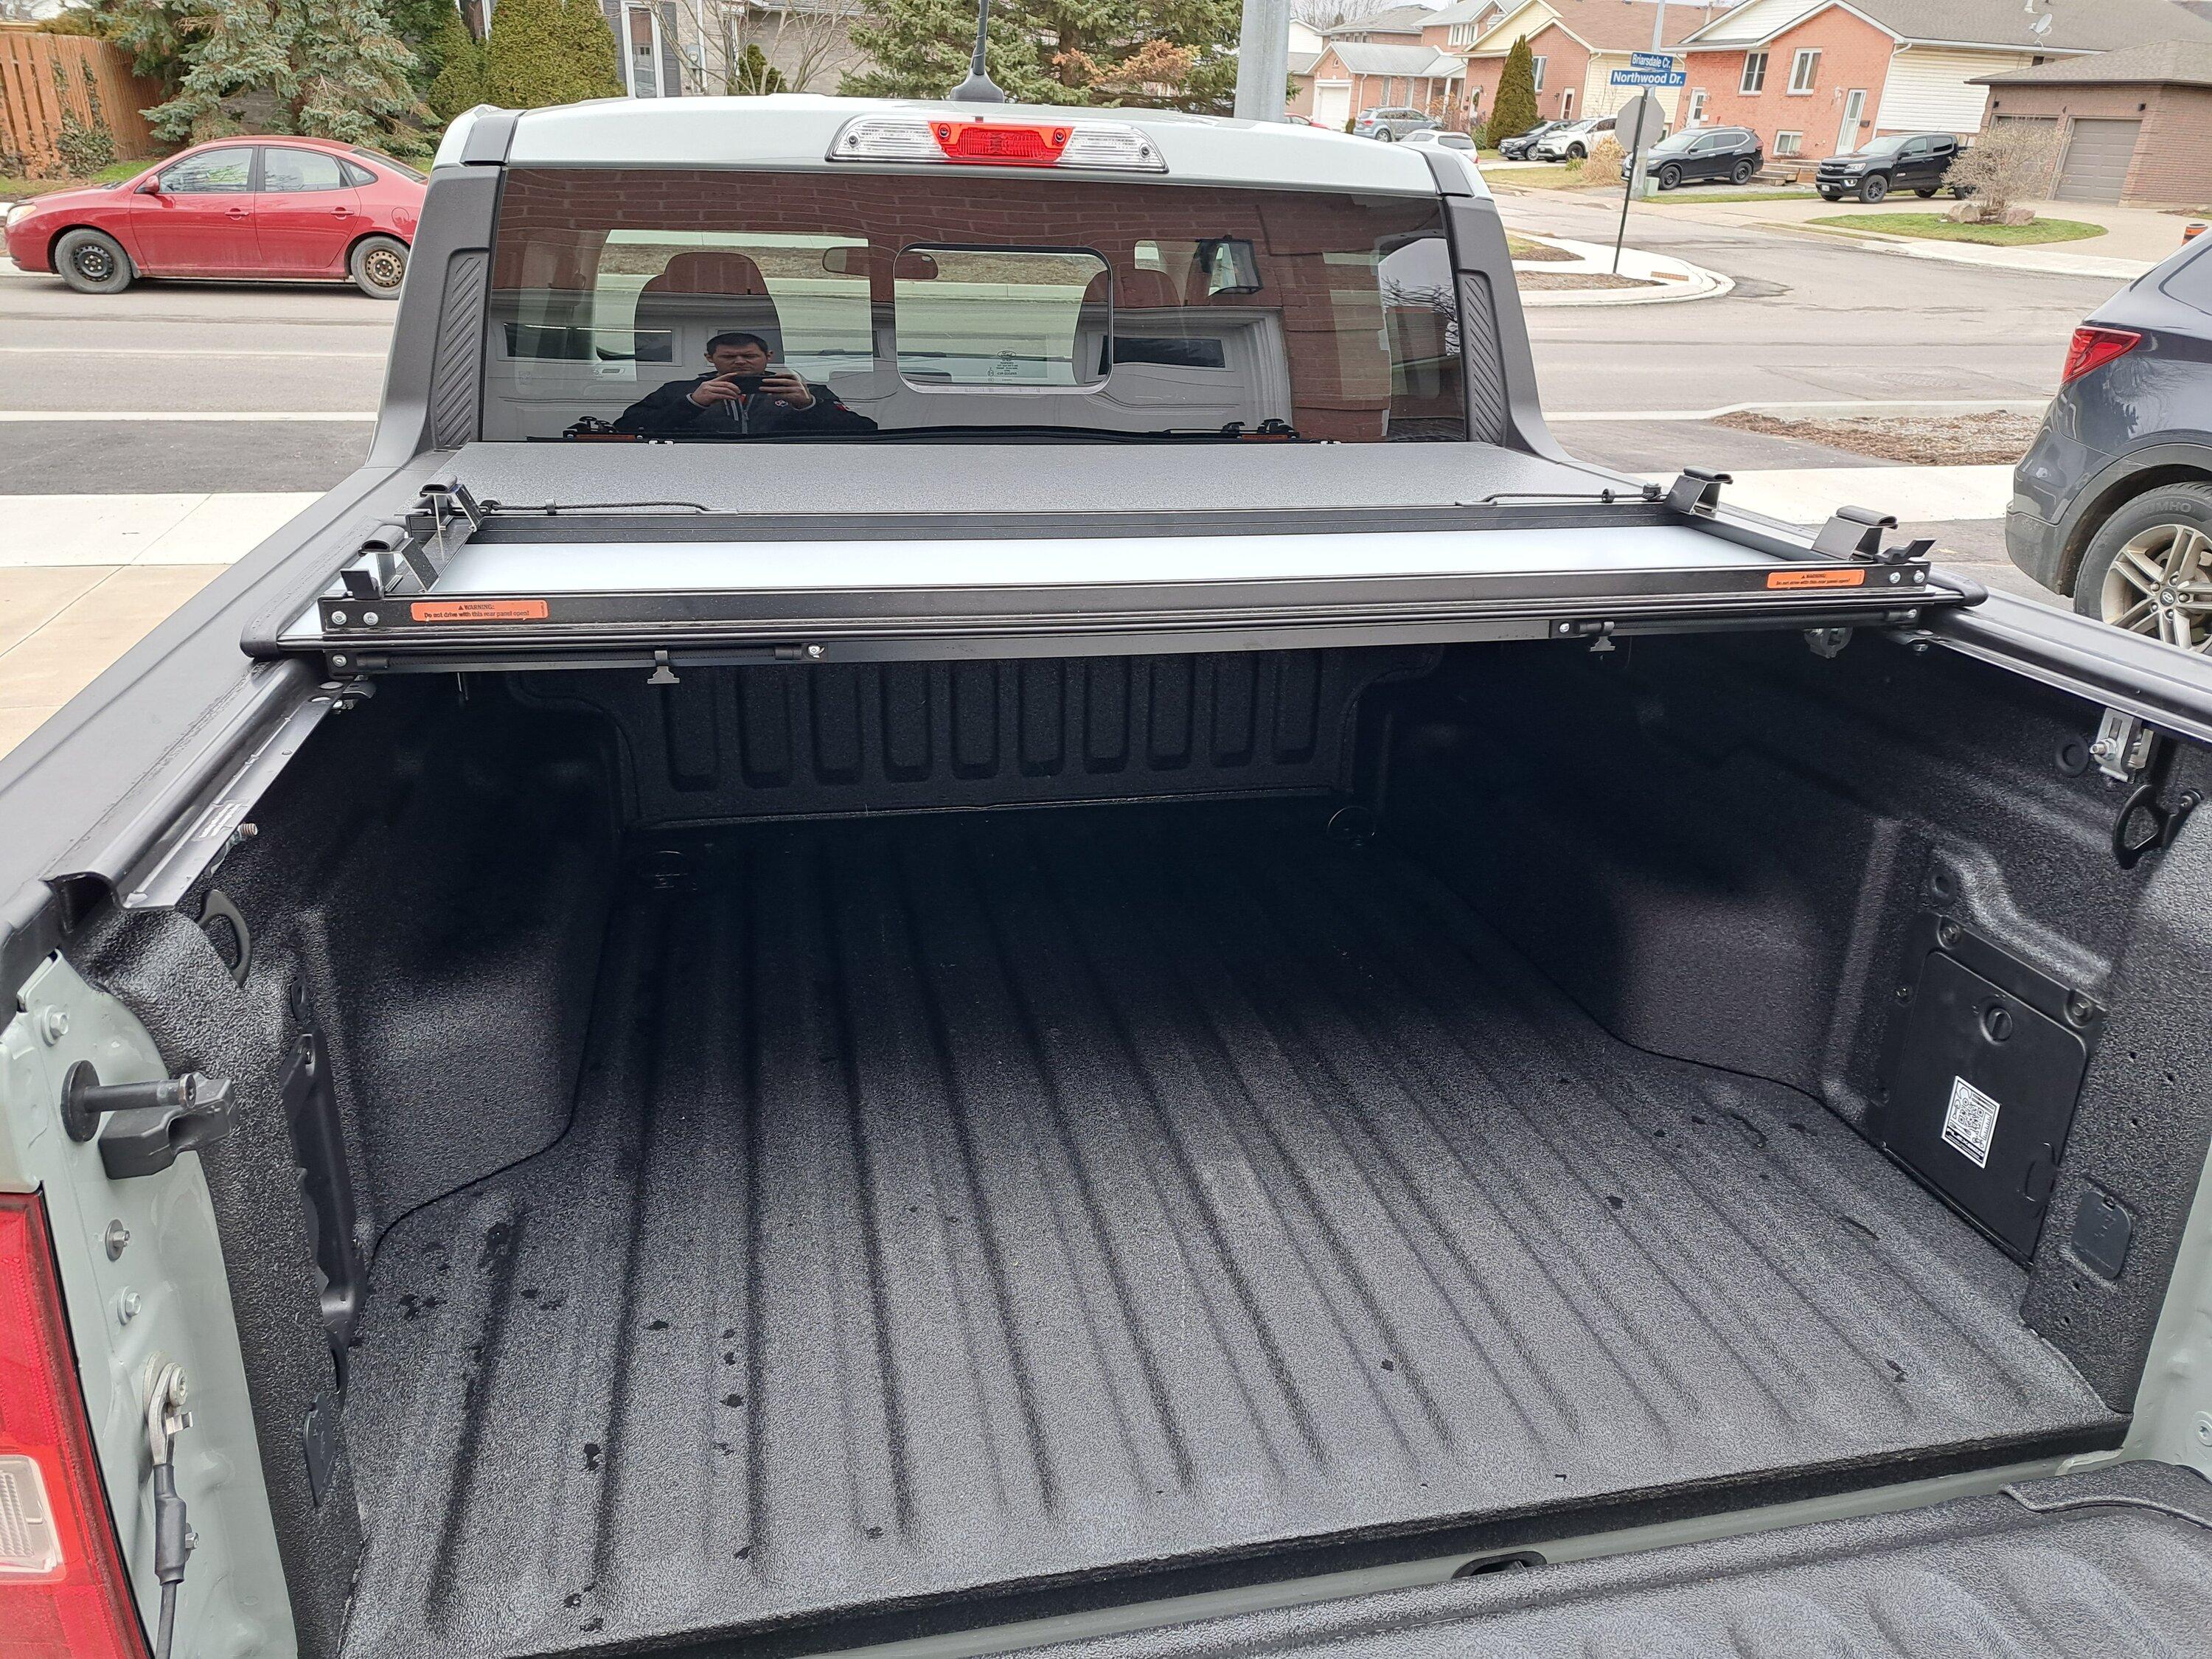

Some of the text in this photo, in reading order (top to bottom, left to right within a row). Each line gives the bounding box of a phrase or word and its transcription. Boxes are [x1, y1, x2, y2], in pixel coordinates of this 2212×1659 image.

[1632, 54, 1671, 69] Briarsdale Cr.
[1613, 72, 1683, 84] Northwood Dr.
